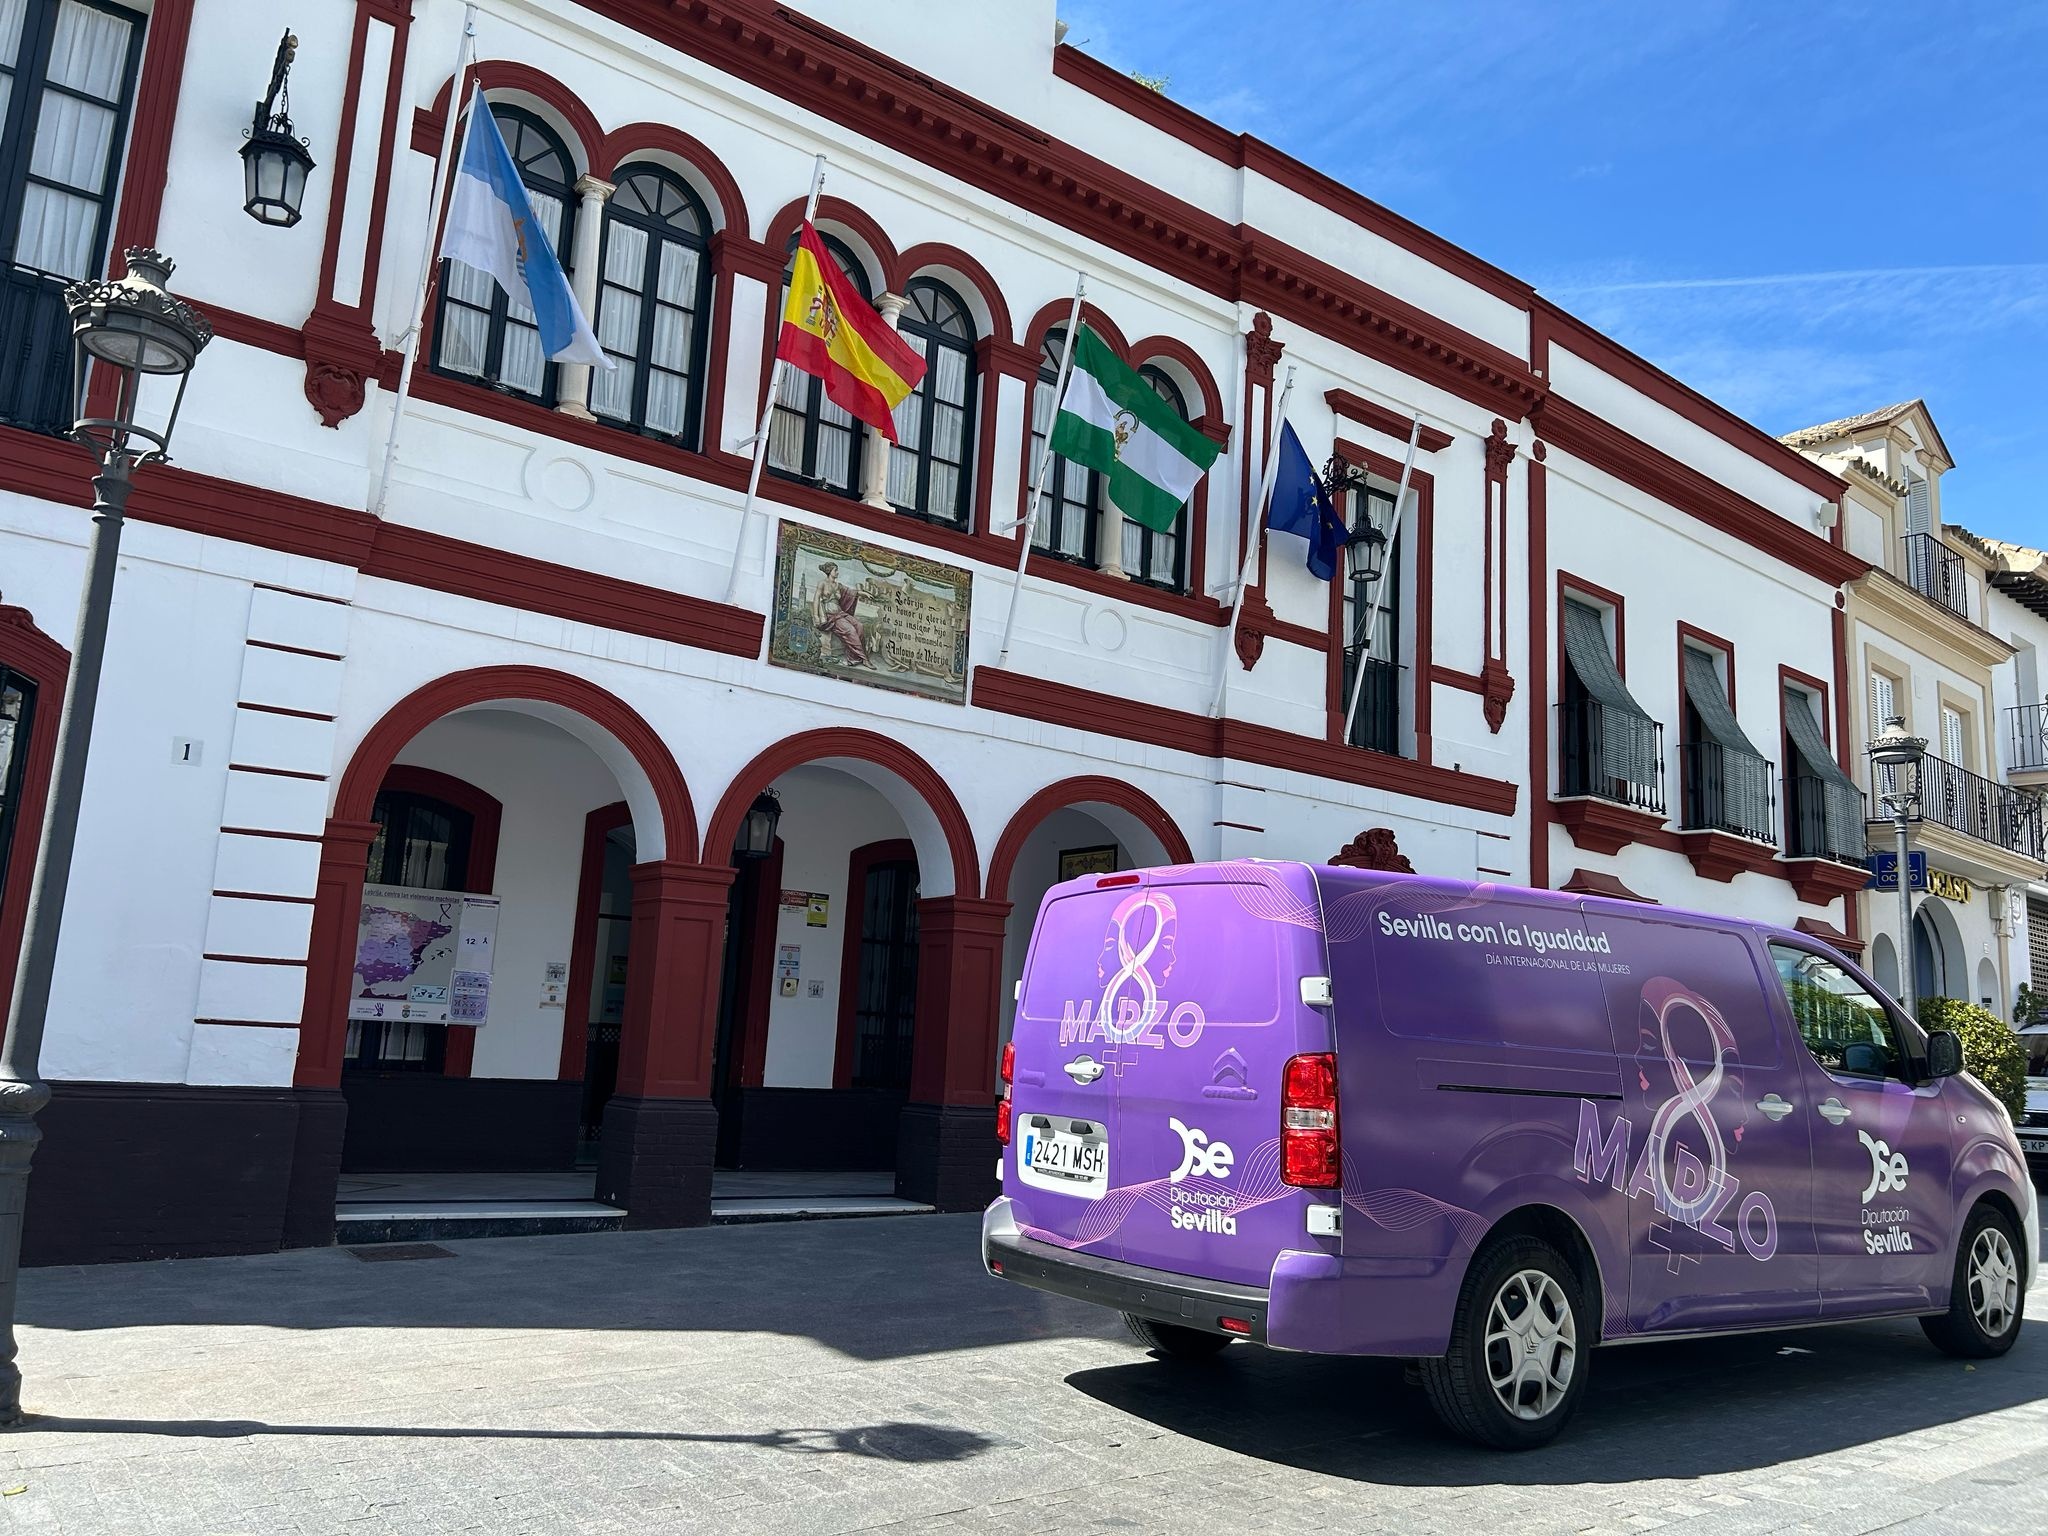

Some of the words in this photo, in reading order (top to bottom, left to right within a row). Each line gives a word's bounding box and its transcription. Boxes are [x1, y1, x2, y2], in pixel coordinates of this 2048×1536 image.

[1881, 873, 1918, 882] OCO
[1927, 867, 1972, 905] OCASO
[465, 937, 476, 945] 12
[1378, 911, 1454, 941] Sevilla
[1457, 923, 1499, 944] con
[1499, 921, 1522, 946] la
[1523, 924, 1612, 954] Igualdad
[1503, 955, 1570, 971] INTERNACIONAL
[1570, 960, 1582, 971] DE
[1582, 961, 1597, 972] LAS
[1598, 962, 1631, 975] MUJERES
[1059, 997, 1206, 1049] MARZO
[1034, 1140, 1067, 1167] 2421
[1072, 1145, 1104, 1173] MSH
[1573, 1097, 1779, 1262] MARZO
[1170, 1187, 1236, 1208] Diputación
[1171, 1205, 1237, 1235] Sevilla
[1861, 1206, 1910, 1227] Diputación
[1863, 1226, 1913, 1254] Sevilla
